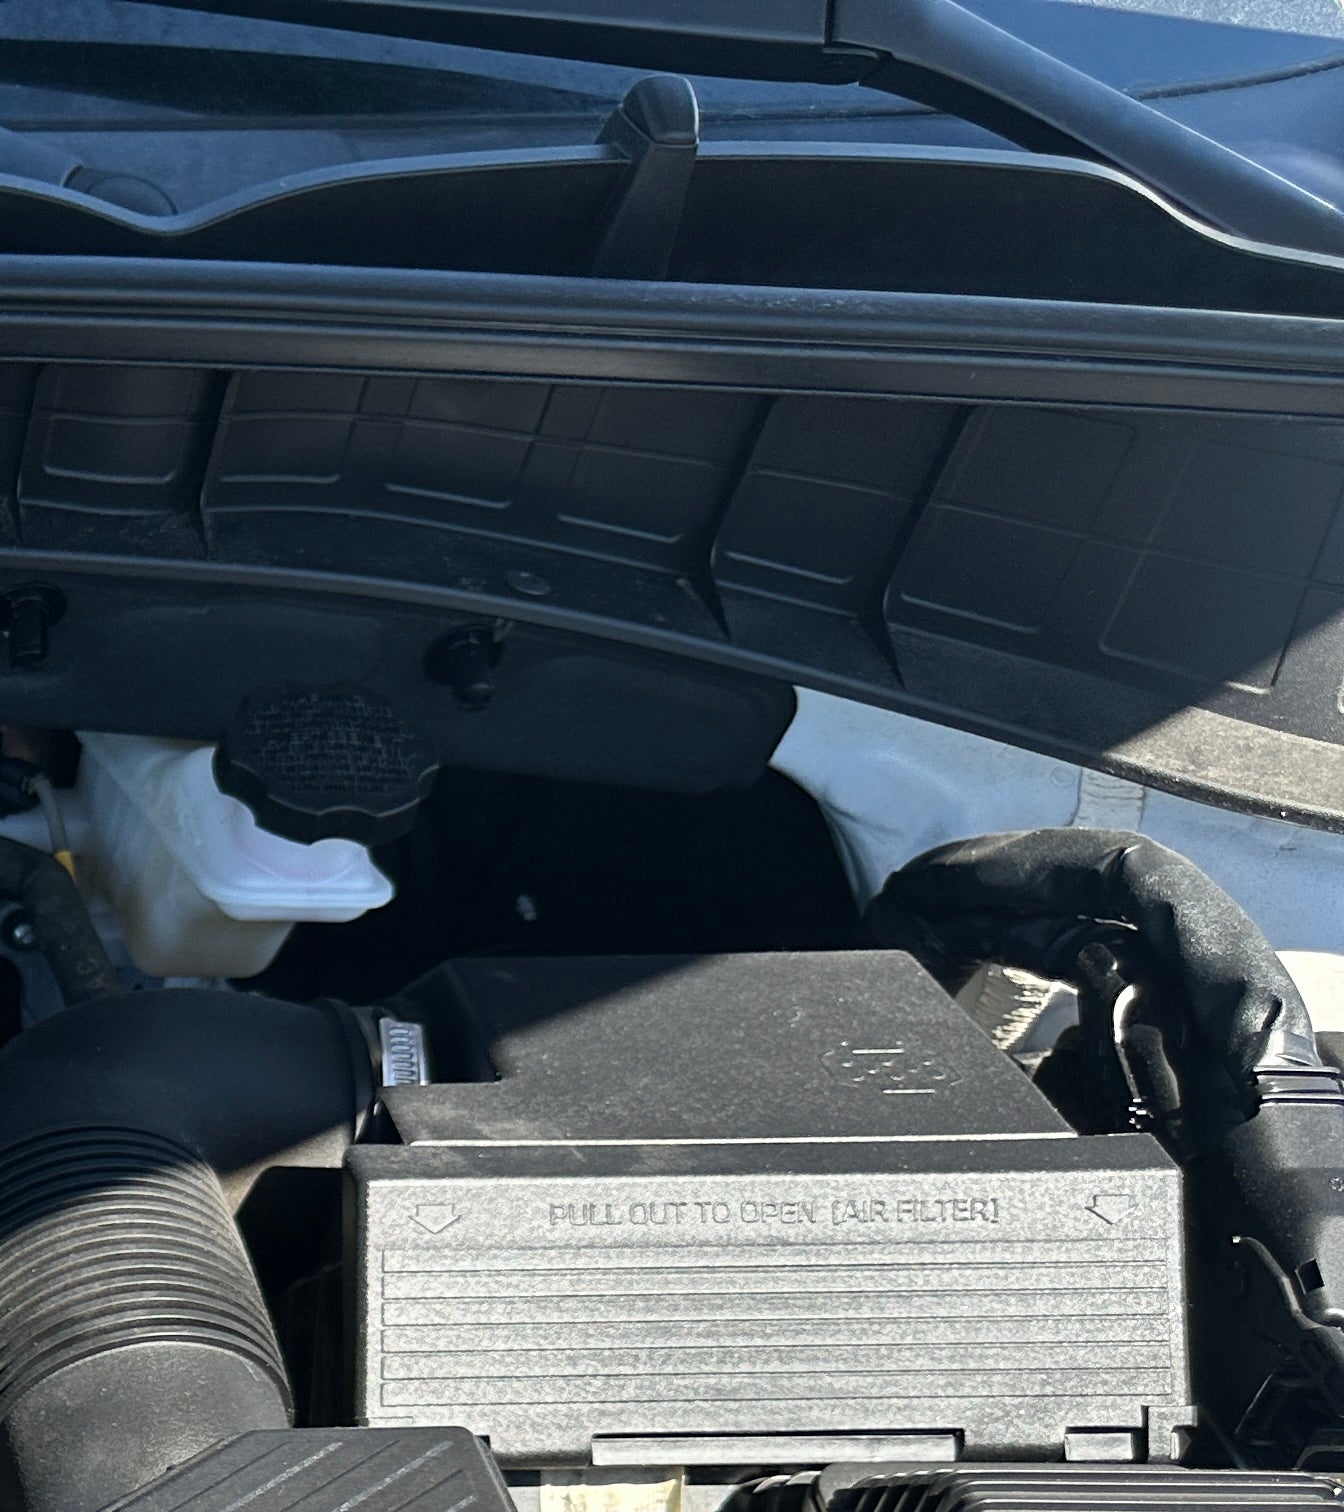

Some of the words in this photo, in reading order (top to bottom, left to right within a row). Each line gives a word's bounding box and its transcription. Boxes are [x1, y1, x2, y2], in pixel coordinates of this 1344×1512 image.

[549, 1202, 622, 1226] PULL
[628, 1202, 687, 1225] OUT
[693, 1202, 730, 1224] TO
[740, 1200, 816, 1224] OPEN
